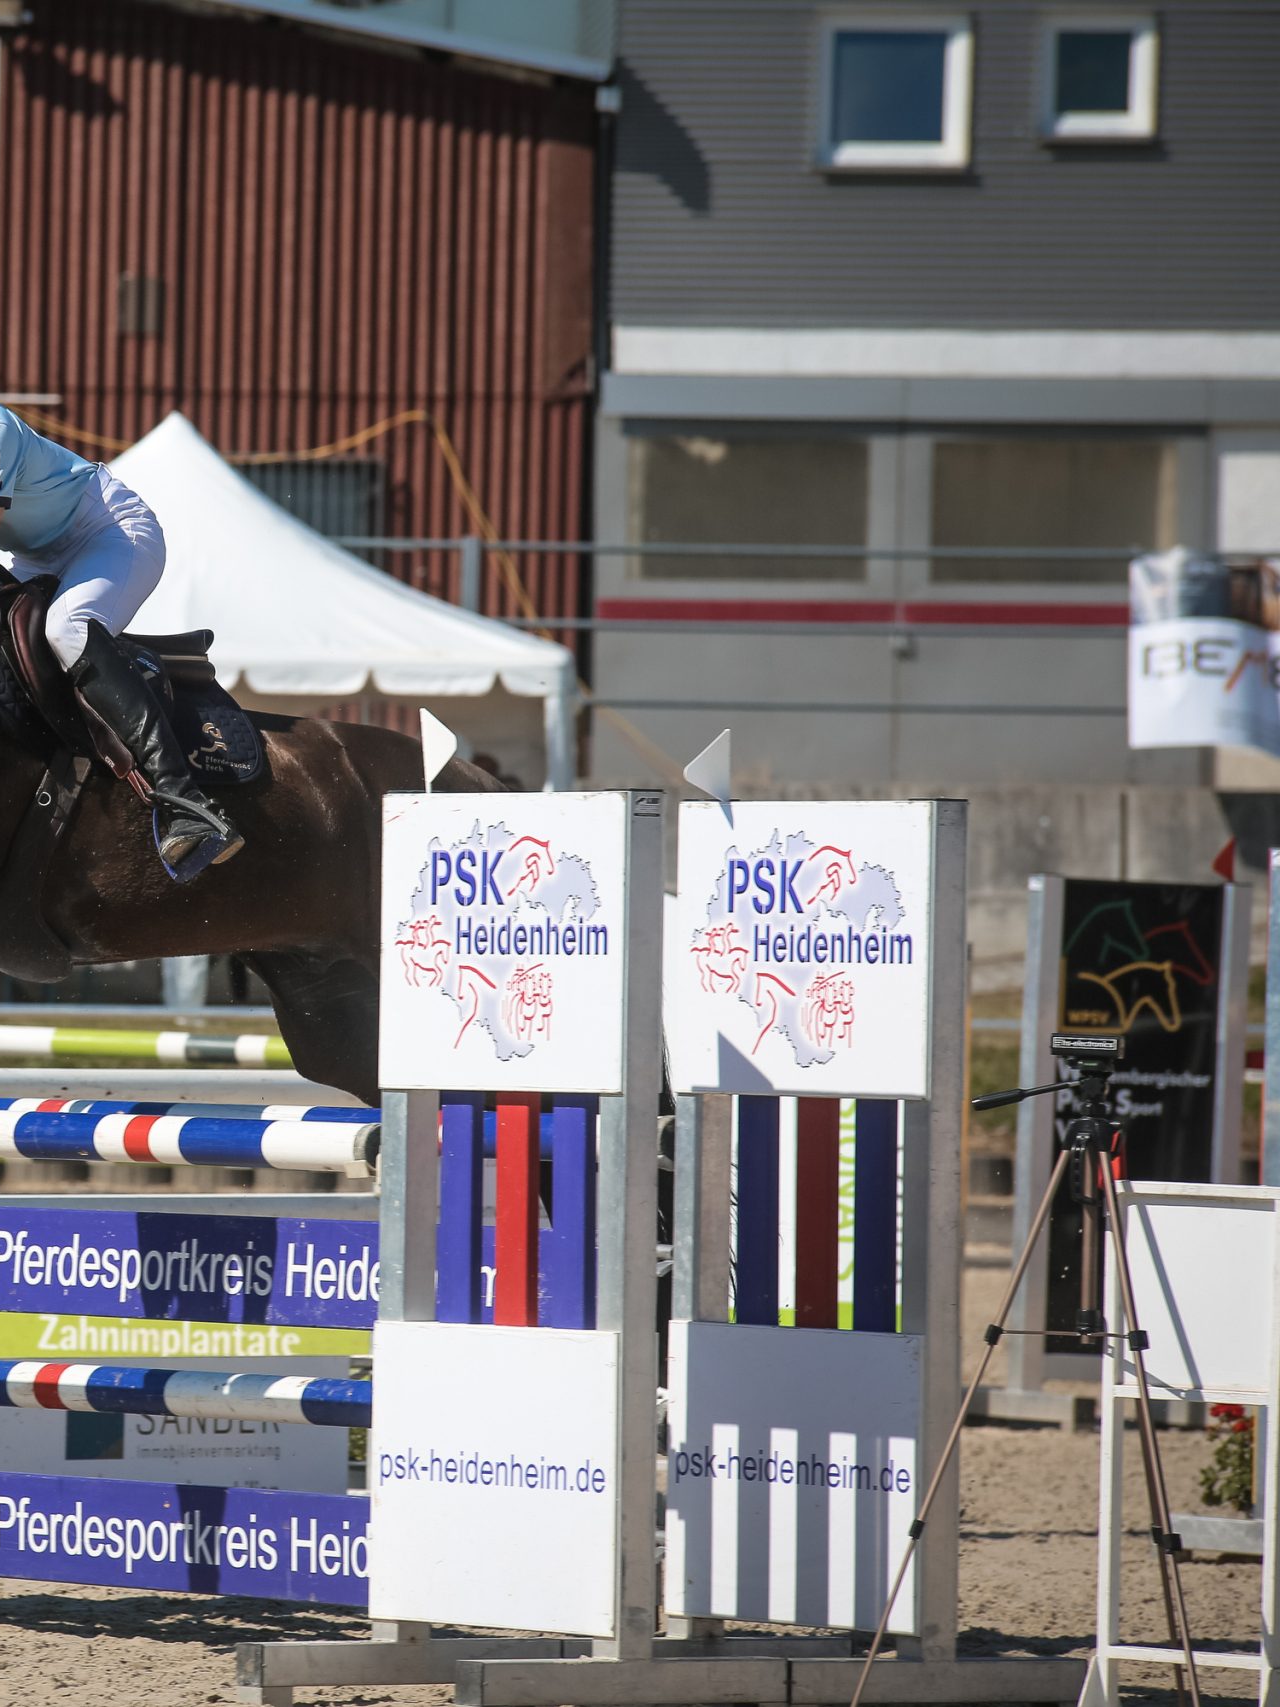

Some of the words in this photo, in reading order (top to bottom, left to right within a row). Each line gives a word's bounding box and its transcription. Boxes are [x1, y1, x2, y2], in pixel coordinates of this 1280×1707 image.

[430, 849, 505, 906] PSK
[727, 858, 804, 914] PSK
[456, 916, 608, 956] Heidenheim
[754, 923, 912, 964] Heidenheim
[37, 1314, 300, 1357] Zahnimplantate
[379, 1448, 606, 1494] psk-heidenheim.de
[675, 1445, 911, 1494] psk-heidenheim.de
[290, 1516, 369, 1578] Heid
